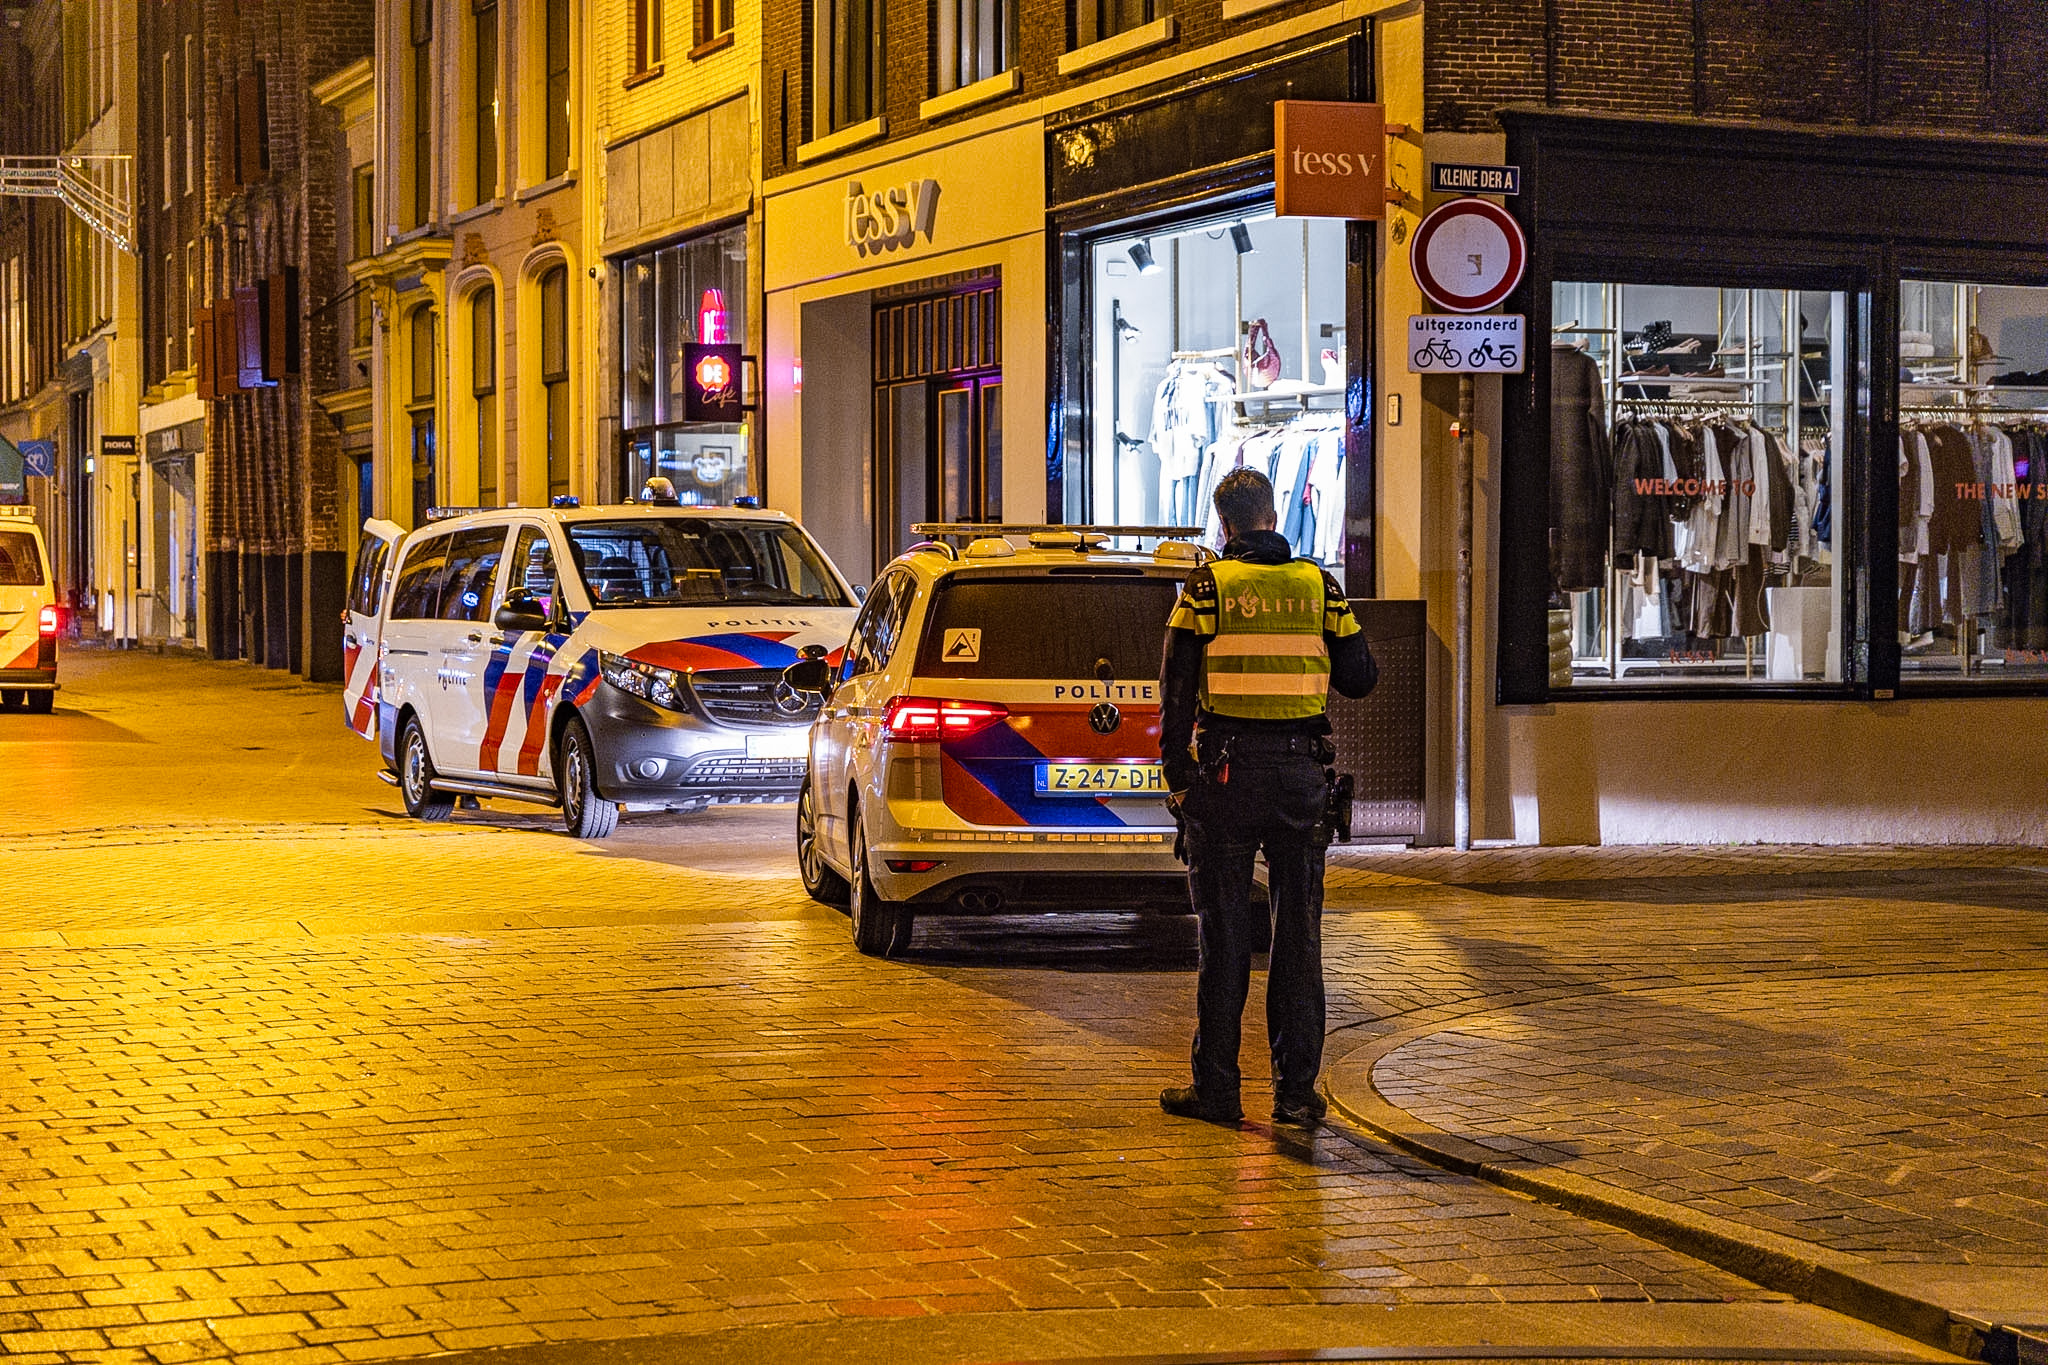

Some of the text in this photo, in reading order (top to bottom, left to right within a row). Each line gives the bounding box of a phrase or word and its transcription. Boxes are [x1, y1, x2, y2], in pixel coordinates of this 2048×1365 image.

[1293, 144, 1377, 177] tess v
[1439, 167, 1514, 190] KLEINE DER A
[843, 180, 900, 247] tess
[1415, 318, 1518, 334] uitgezonderd
[703, 364, 723, 383] DE
[702, 386, 738, 409] Café
[105, 441, 133, 449] ROKA
[1634, 478, 1756, 496] WELCOME TO
[1955, 482, 2048, 500] THE NEW S
[707, 619, 813, 628] POLITIE
[1054, 685, 1153, 699] POLITIE
[1055, 768, 1162, 789] Z-247-DH
